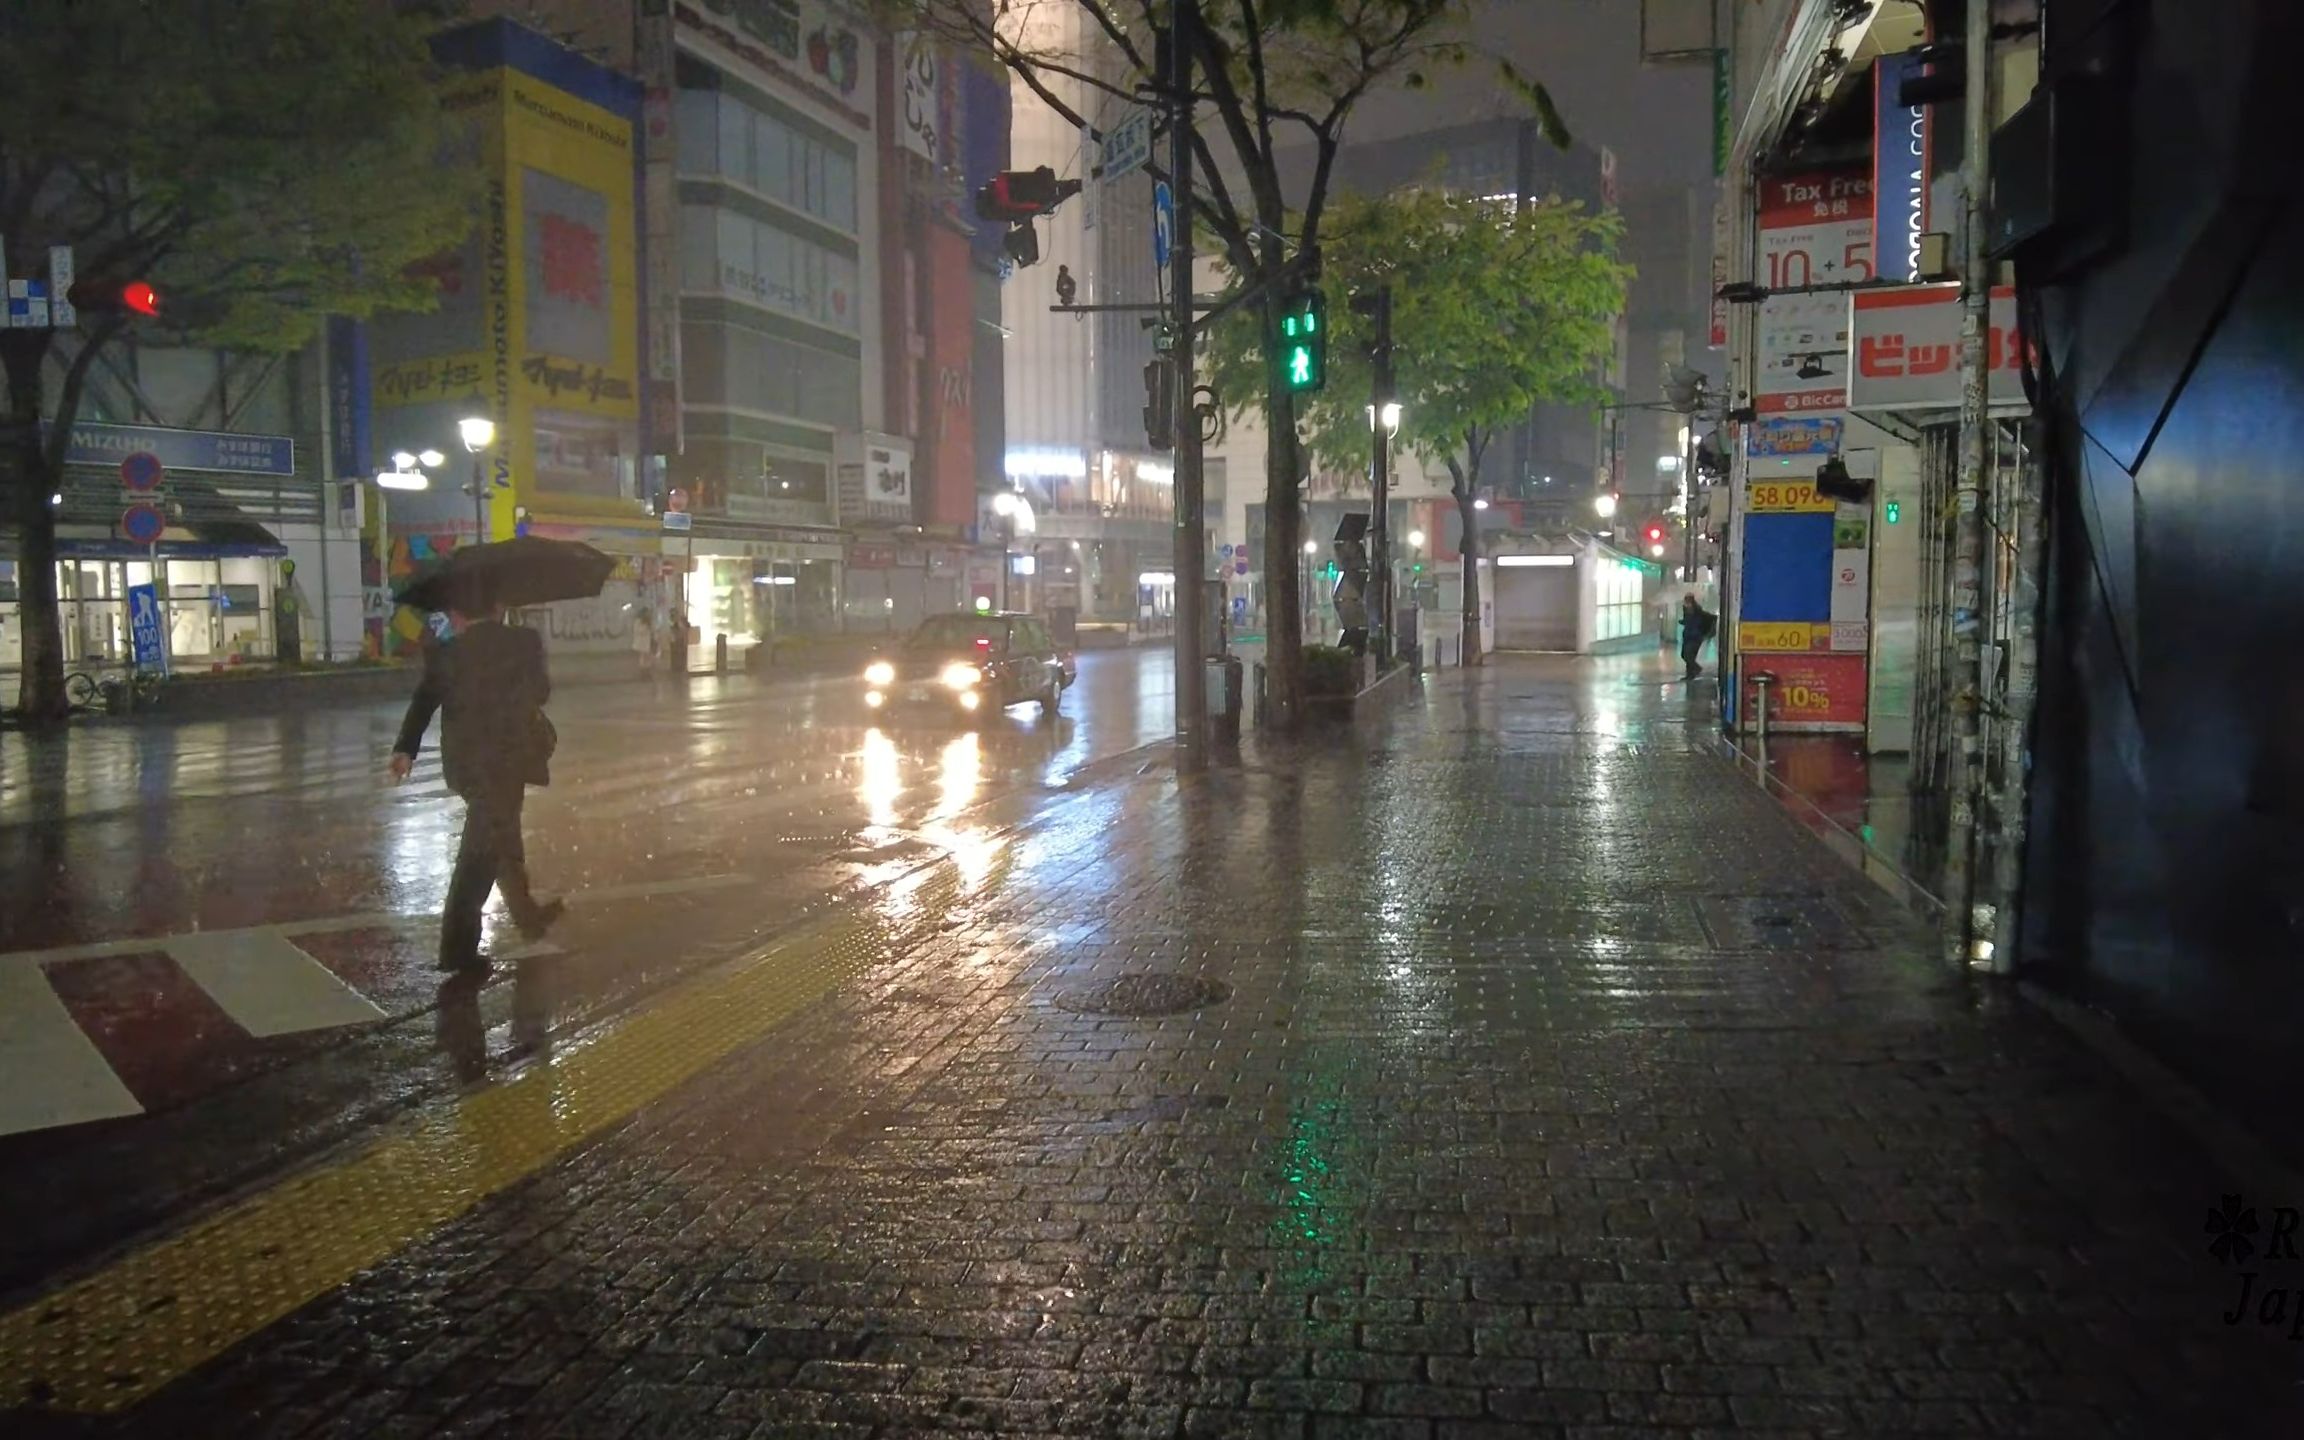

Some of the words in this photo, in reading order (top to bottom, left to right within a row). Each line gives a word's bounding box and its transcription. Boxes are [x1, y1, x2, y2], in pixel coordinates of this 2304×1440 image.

[1781, 182, 1821, 204] Tax
[70, 431, 157, 452] MIZUHO
[1781, 686, 1830, 709] 10%
